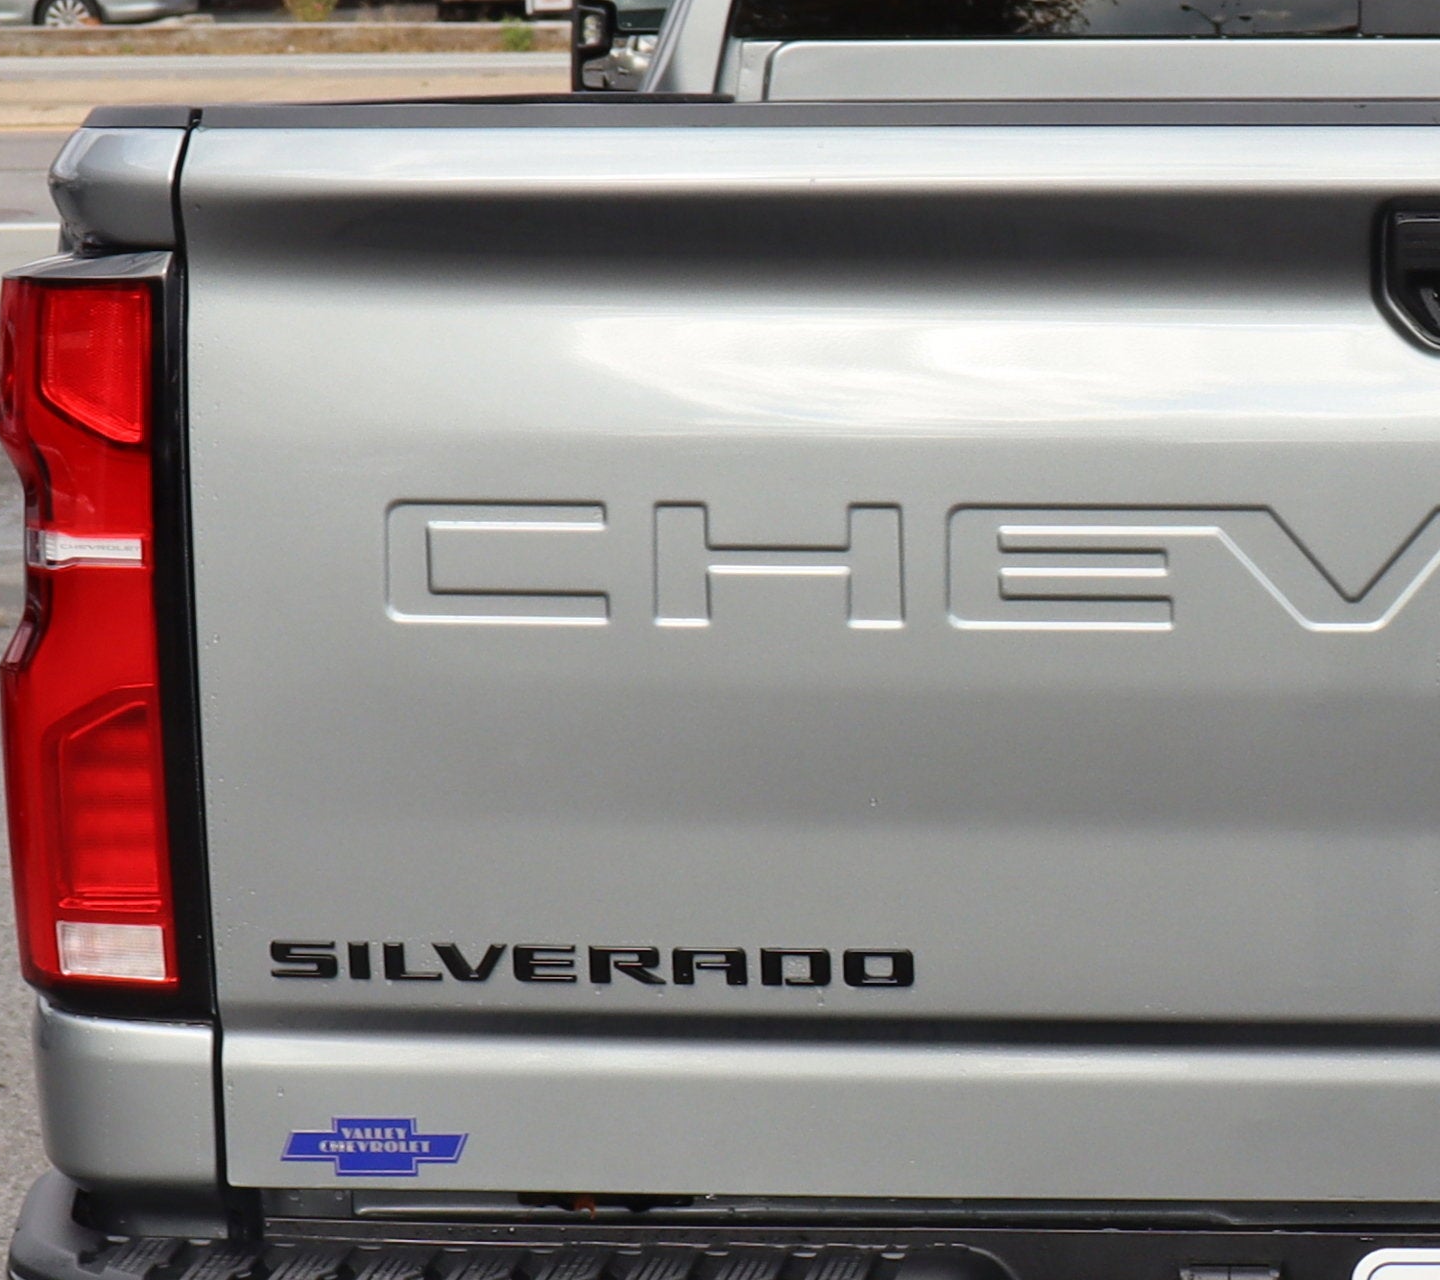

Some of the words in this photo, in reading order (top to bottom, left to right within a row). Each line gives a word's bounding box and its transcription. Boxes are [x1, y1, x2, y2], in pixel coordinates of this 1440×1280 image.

[270, 940, 915, 988] SILVERADO
[340, 1127, 408, 1140] VALLEY
[318, 1140, 431, 1153] CHEVROLET
